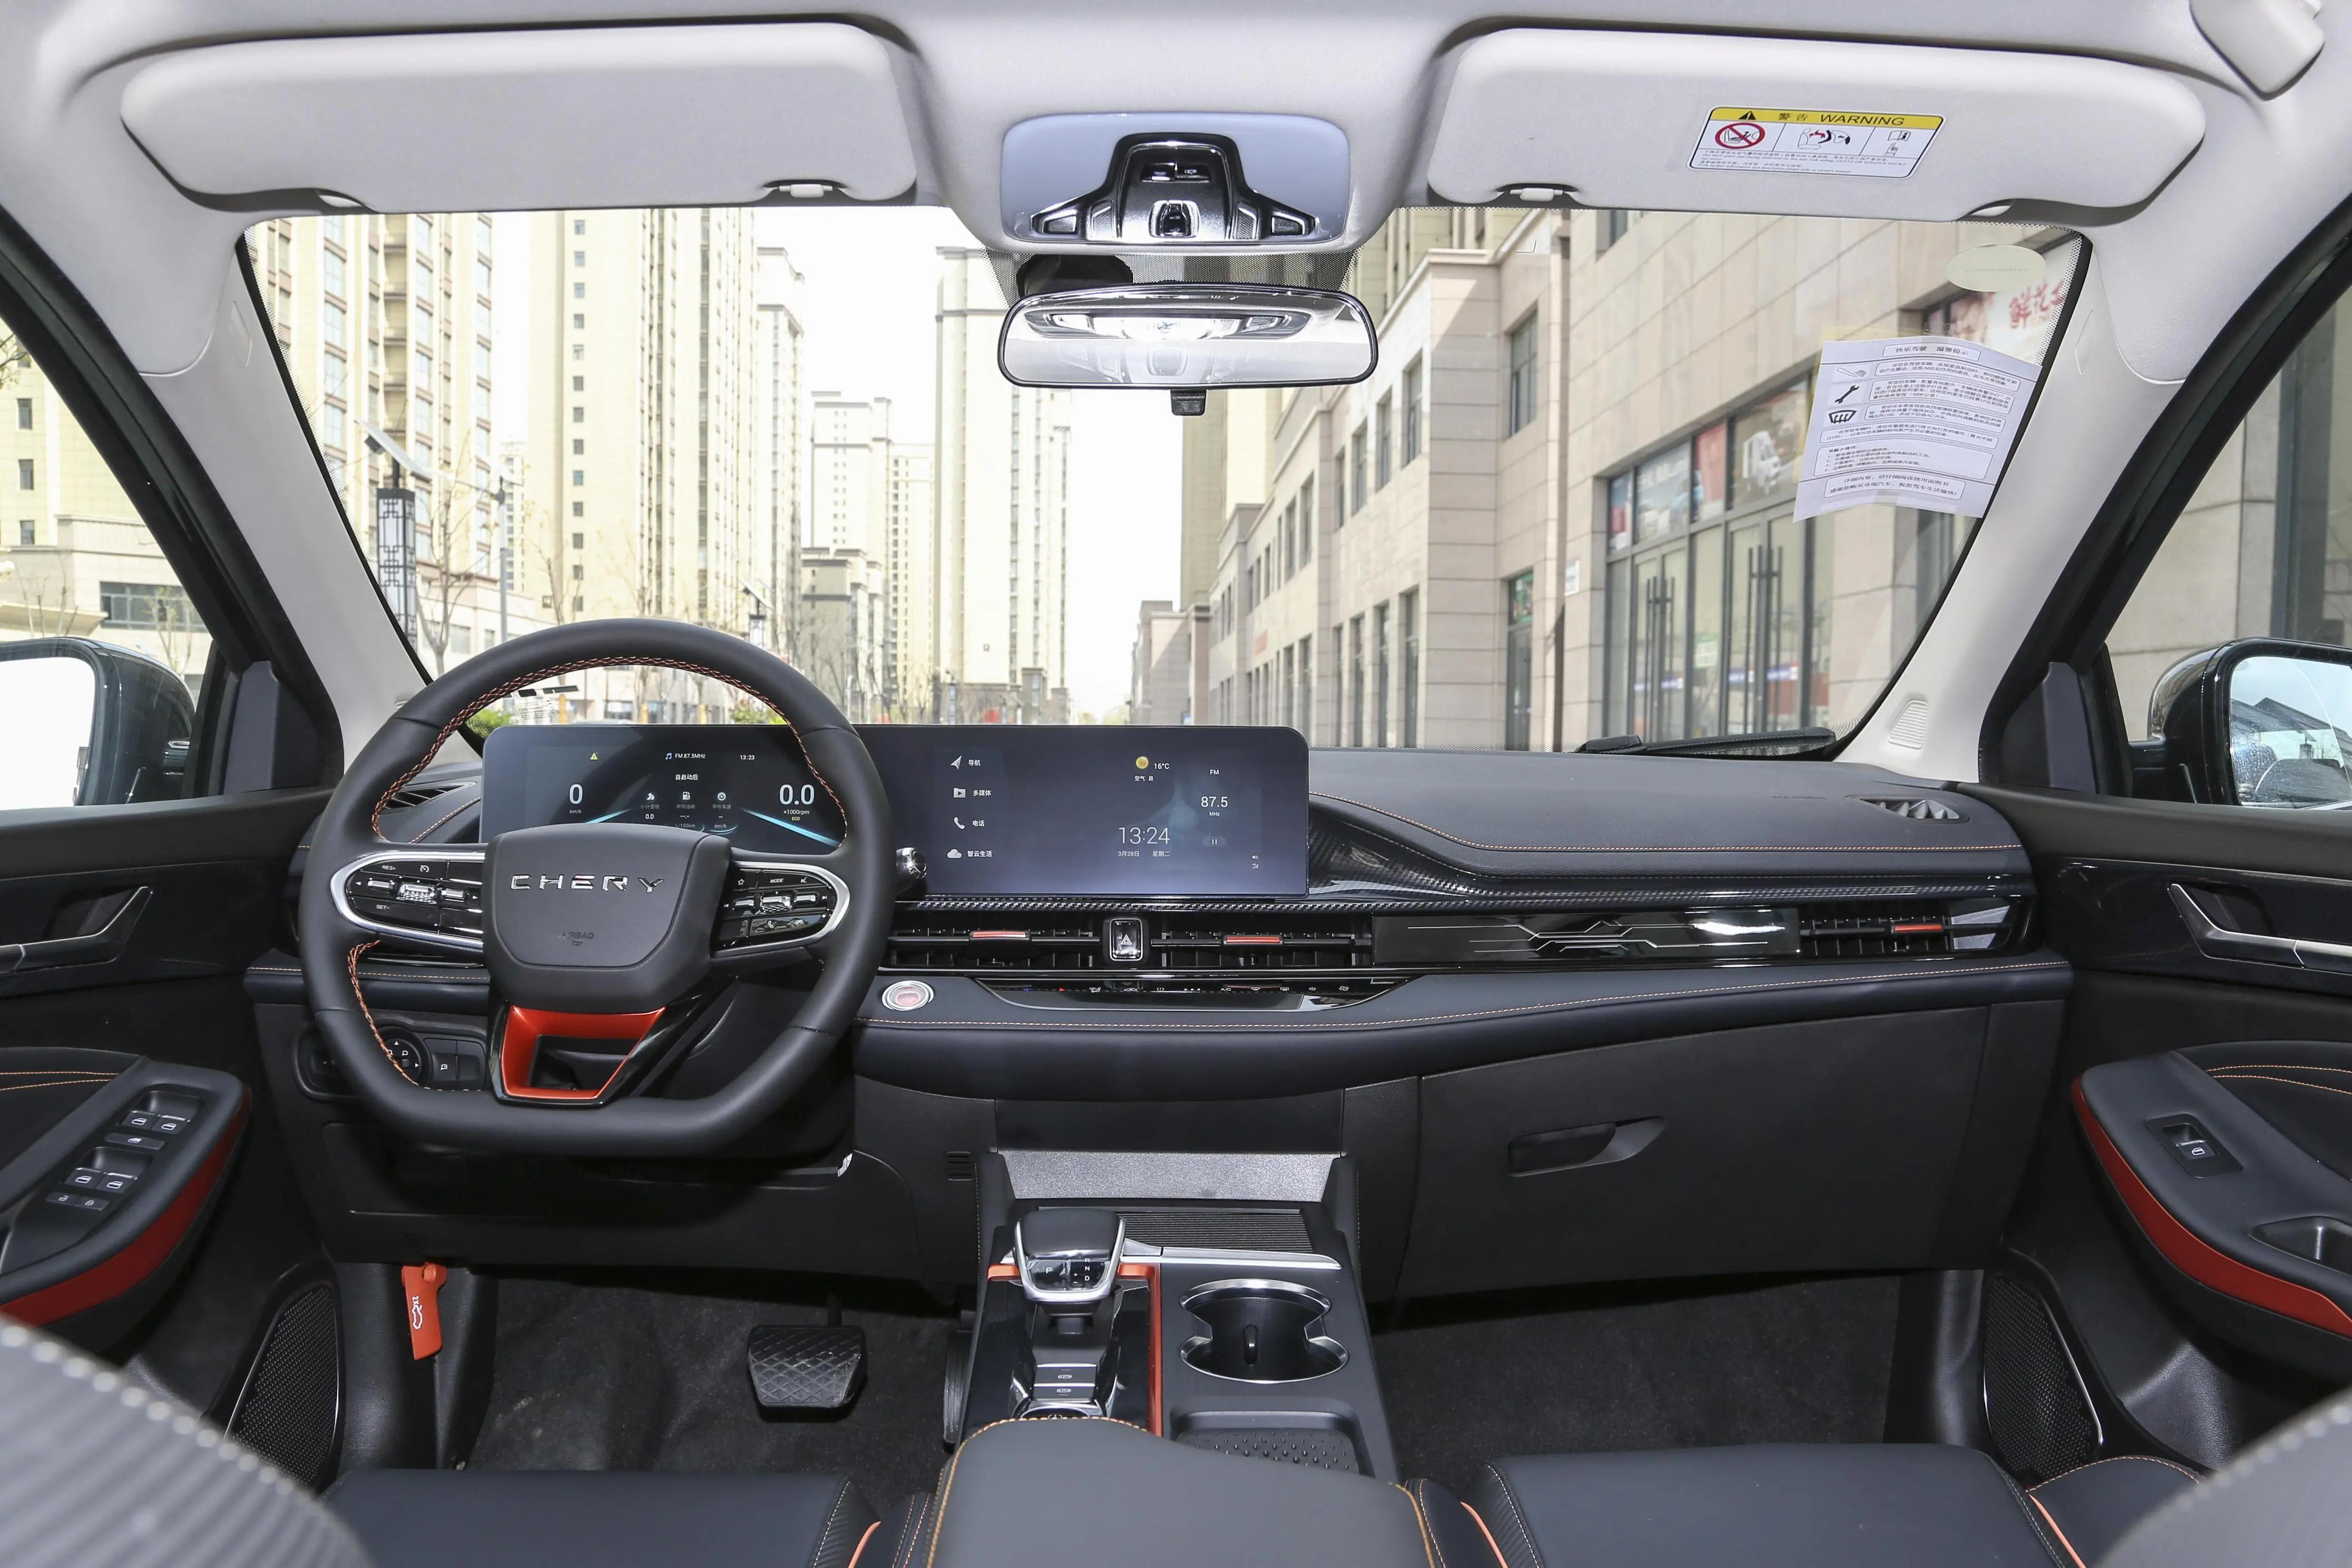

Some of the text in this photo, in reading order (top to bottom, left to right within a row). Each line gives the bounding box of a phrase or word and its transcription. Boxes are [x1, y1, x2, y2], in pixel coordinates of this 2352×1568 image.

[1779, 113, 1808, 121] 警告
[1820, 114, 1905, 125] WARNING
[569, 783, 583, 805] 0
[779, 784, 815, 805] 0.0
[1201, 796, 1228, 808] 87.5
[1118, 827, 1171, 844] 13:24
[510, 874, 665, 894] CHERY
